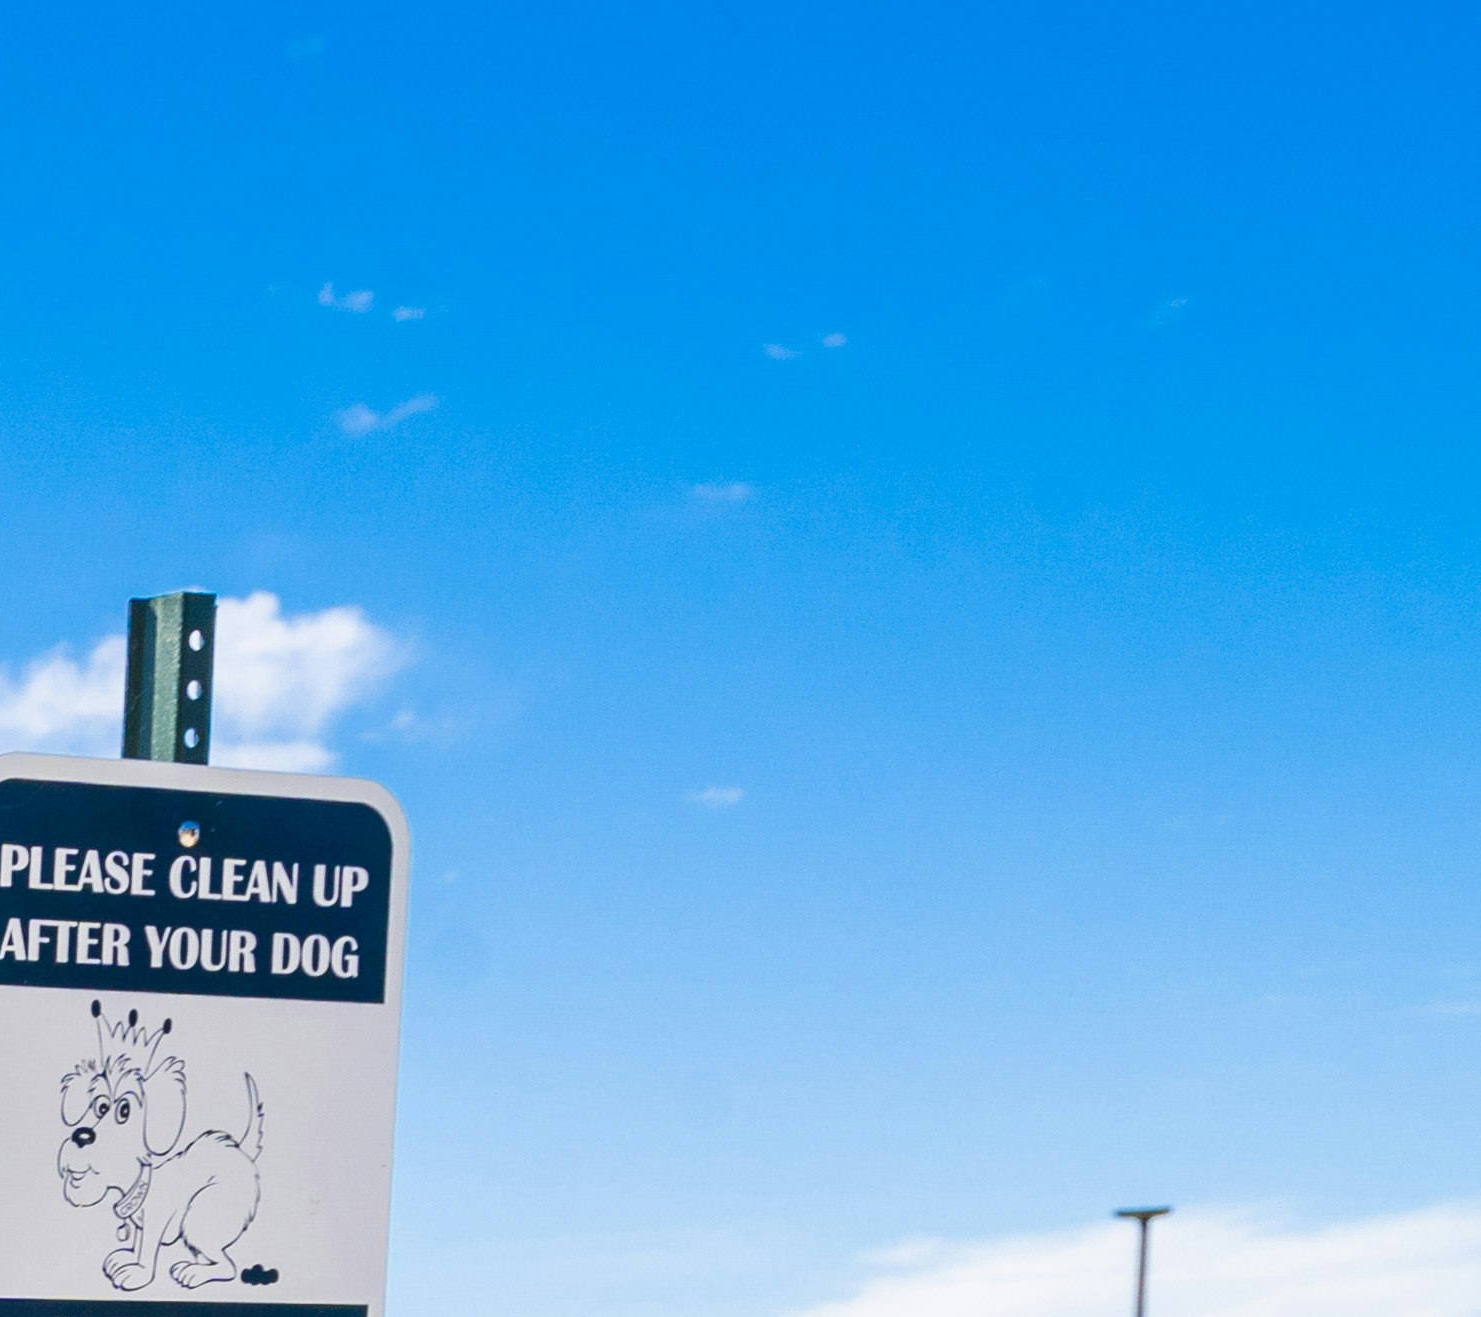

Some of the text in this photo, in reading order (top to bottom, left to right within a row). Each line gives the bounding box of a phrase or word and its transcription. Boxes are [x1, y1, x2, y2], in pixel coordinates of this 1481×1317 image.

[0, 843, 370, 908] PLEASE CLEAN UP
[143, 925, 257, 974] YOUR
[270, 932, 360, 978] DOG
